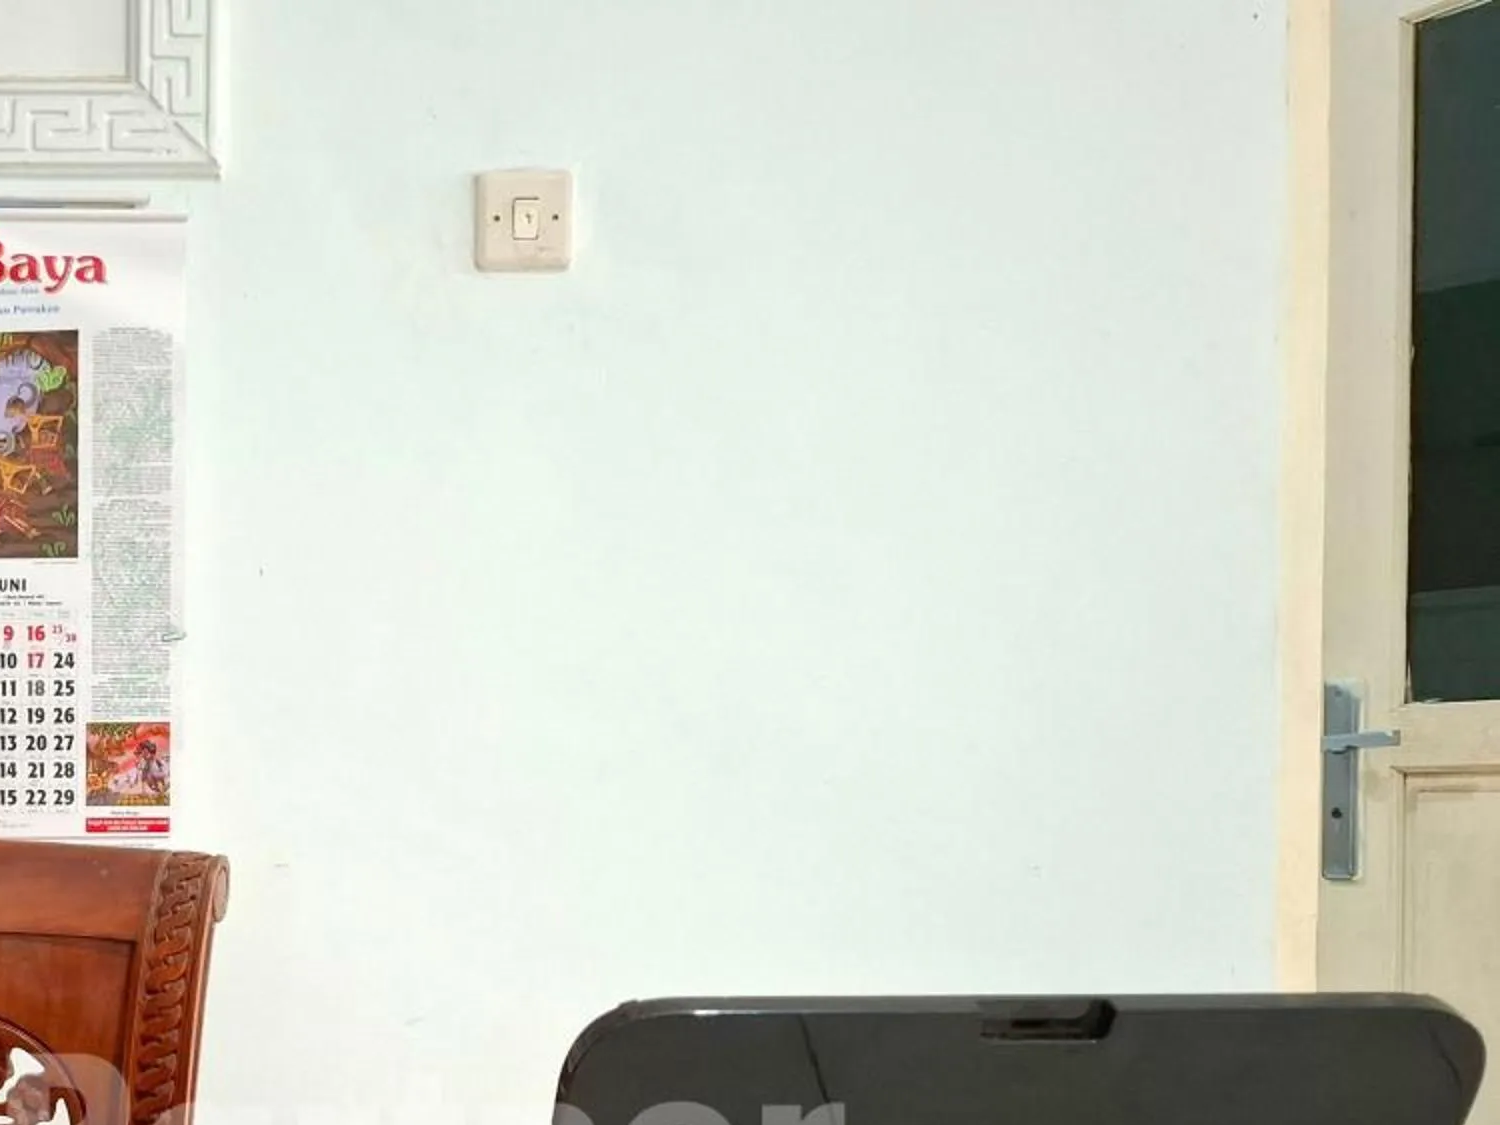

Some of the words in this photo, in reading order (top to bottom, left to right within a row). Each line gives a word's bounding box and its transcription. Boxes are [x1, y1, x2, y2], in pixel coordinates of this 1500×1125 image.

[3, 625, 14, 642] 9
[27, 625, 46, 642] 16
[0, 652, 18, 669] 10
[27, 652, 45, 669] 17
[53, 652, 75, 669] 24
[1, 680, 17, 697] 11
[27, 679, 46, 697] 18
[53, 679, 75, 697] 25
[0, 707, 17, 725] 12
[27, 707, 45, 725] 19
[53, 707, 75, 724] 26
[0, 735, 17, 751] 13
[25, 734, 47, 751] 20
[53, 734, 75, 751] 27
[0, 762, 17, 779] 14
[27, 762, 45, 779] 21
[53, 761, 75, 779] 28
[0, 789, 18, 806] 15
[25, 789, 47, 806] 22
[53, 789, 75, 806] 29
